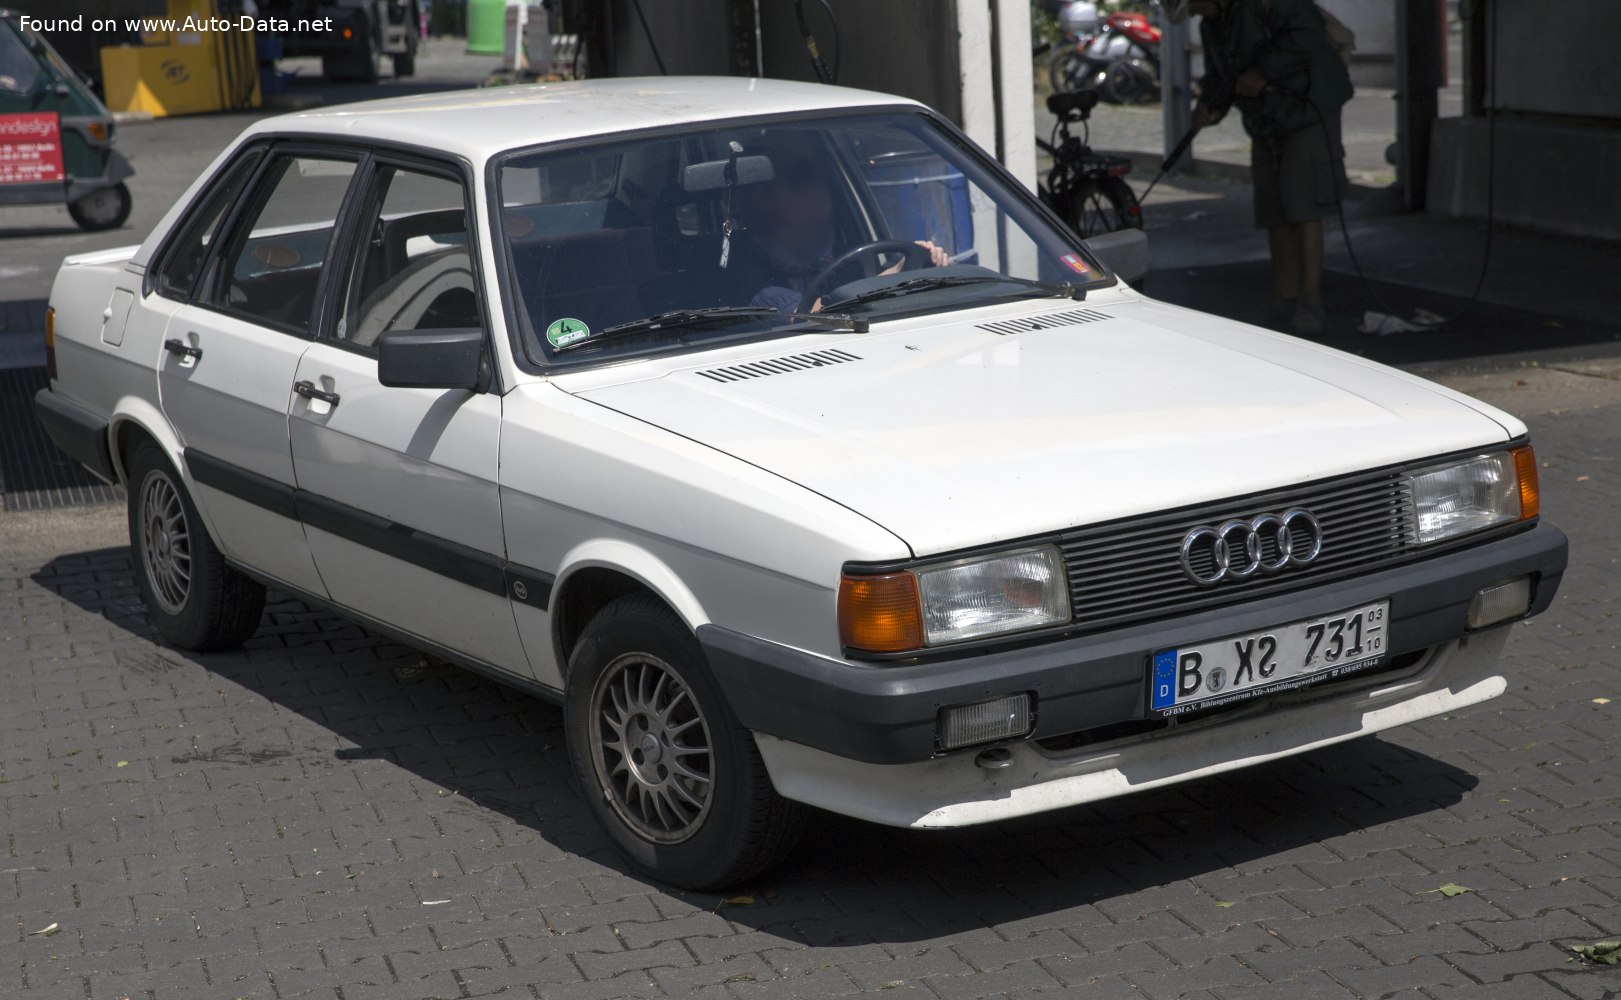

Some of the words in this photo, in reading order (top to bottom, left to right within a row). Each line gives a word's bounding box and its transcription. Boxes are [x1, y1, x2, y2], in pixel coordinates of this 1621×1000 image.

[560, 321, 572, 334] 4
[1368, 607, 1383, 622] 03
[1366, 637, 1381, 651] 10
[1178, 651, 1203, 698] B
[1303, 612, 1363, 668] 731
[1160, 684, 1169, 698] D
[1162, 705, 1185, 717] GFBM
[1200, 691, 1251, 709] Bildungszentrum
[1251, 673, 1328, 697] Kfz-Ausbildungswerkstatt
